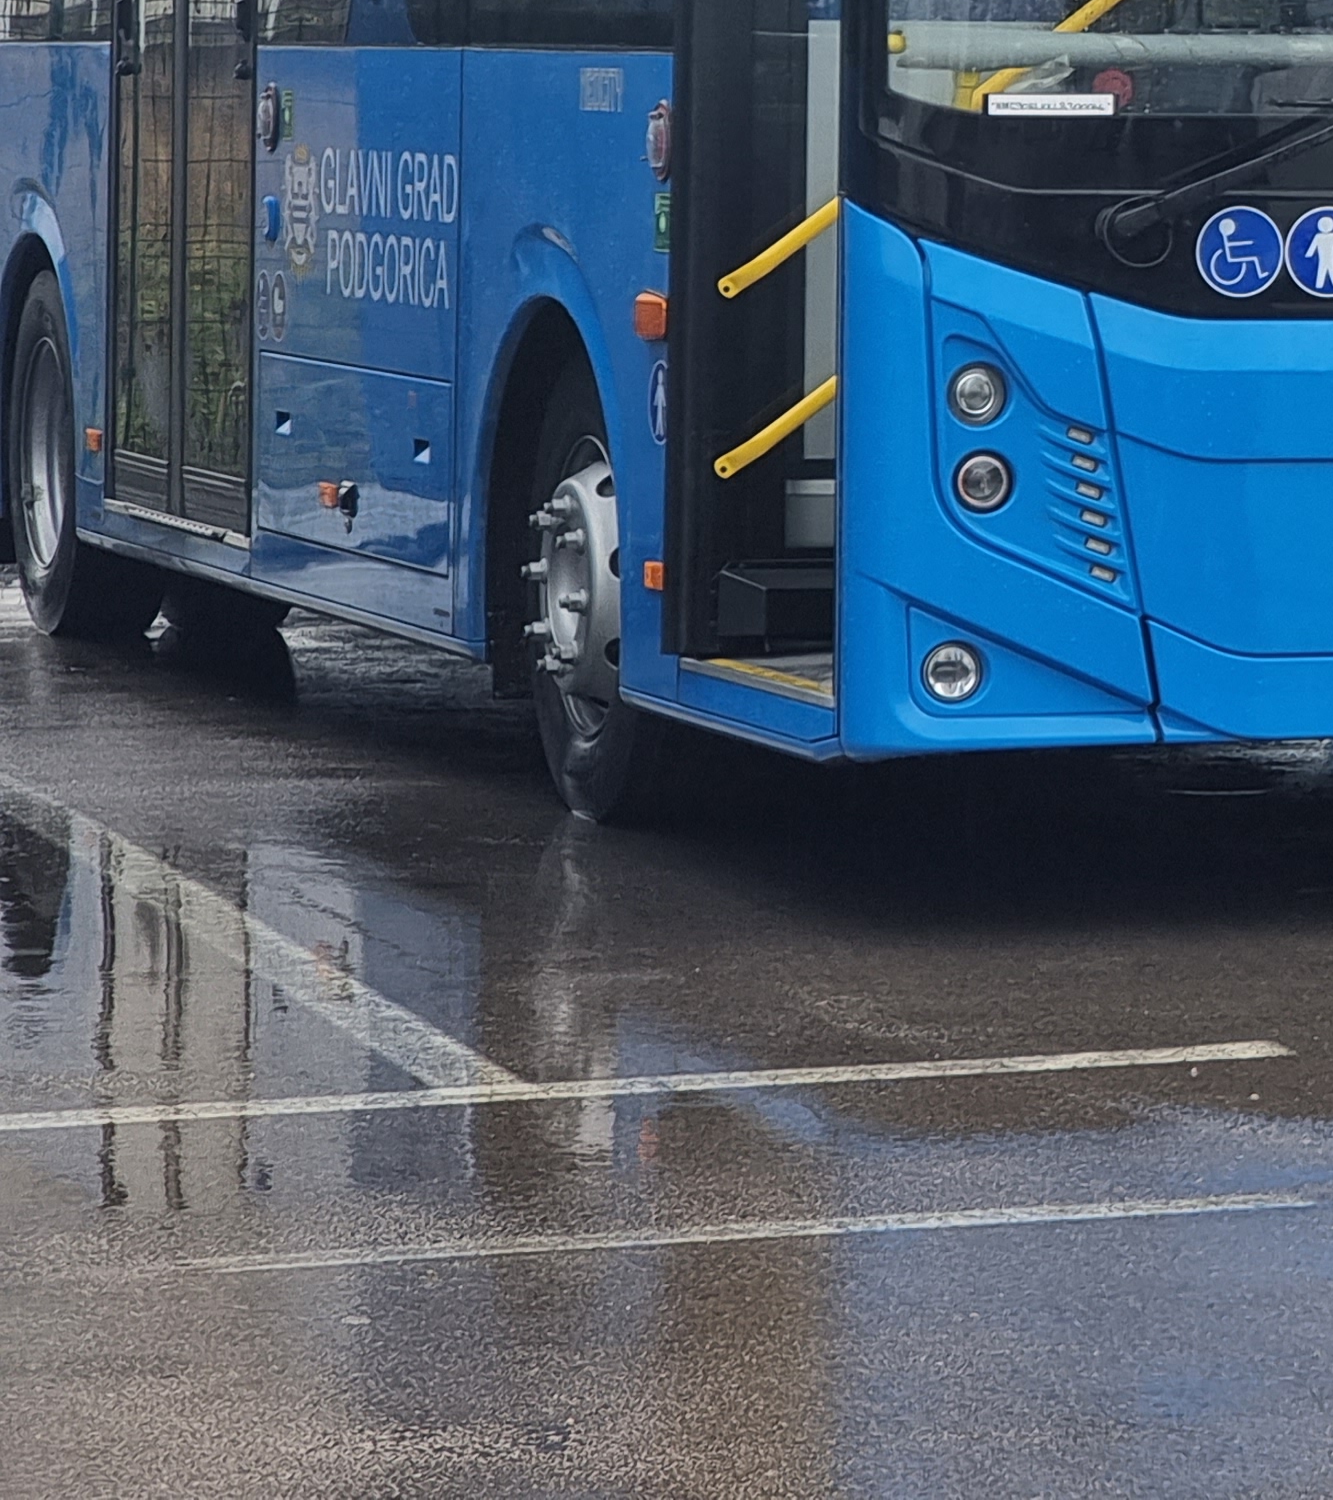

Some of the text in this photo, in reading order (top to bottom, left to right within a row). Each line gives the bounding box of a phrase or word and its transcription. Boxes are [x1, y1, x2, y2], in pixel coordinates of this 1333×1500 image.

[320, 147, 459, 224] GLAVNI GRAD
[326, 229, 450, 310] PODGORICA
